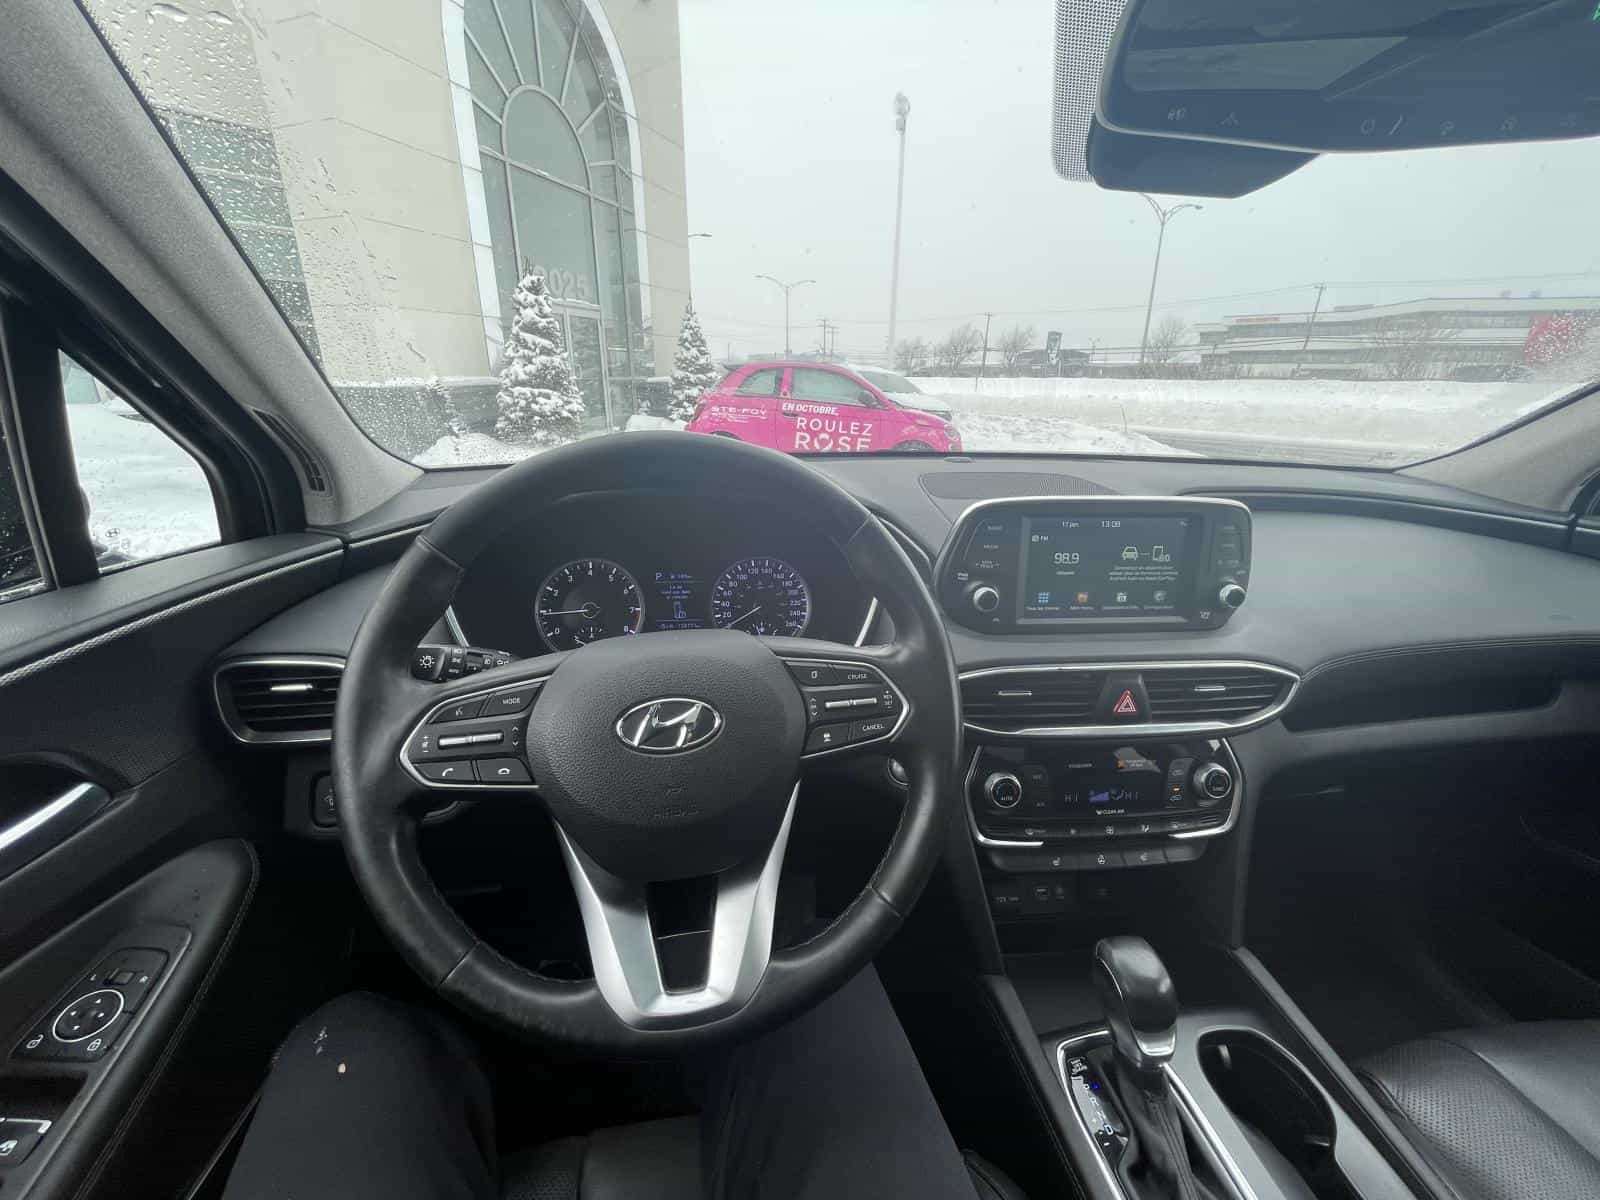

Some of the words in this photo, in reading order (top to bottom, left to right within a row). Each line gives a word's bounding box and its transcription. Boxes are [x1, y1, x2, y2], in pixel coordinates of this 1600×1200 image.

[782, 402, 794, 411] EN
[796, 416, 873, 436] ROULEZ
[794, 431, 872, 453] ROSE
[1053, 552, 1080, 565] 98.9
[655, 572, 663, 580] P
[502, 697, 521, 705] MODE
